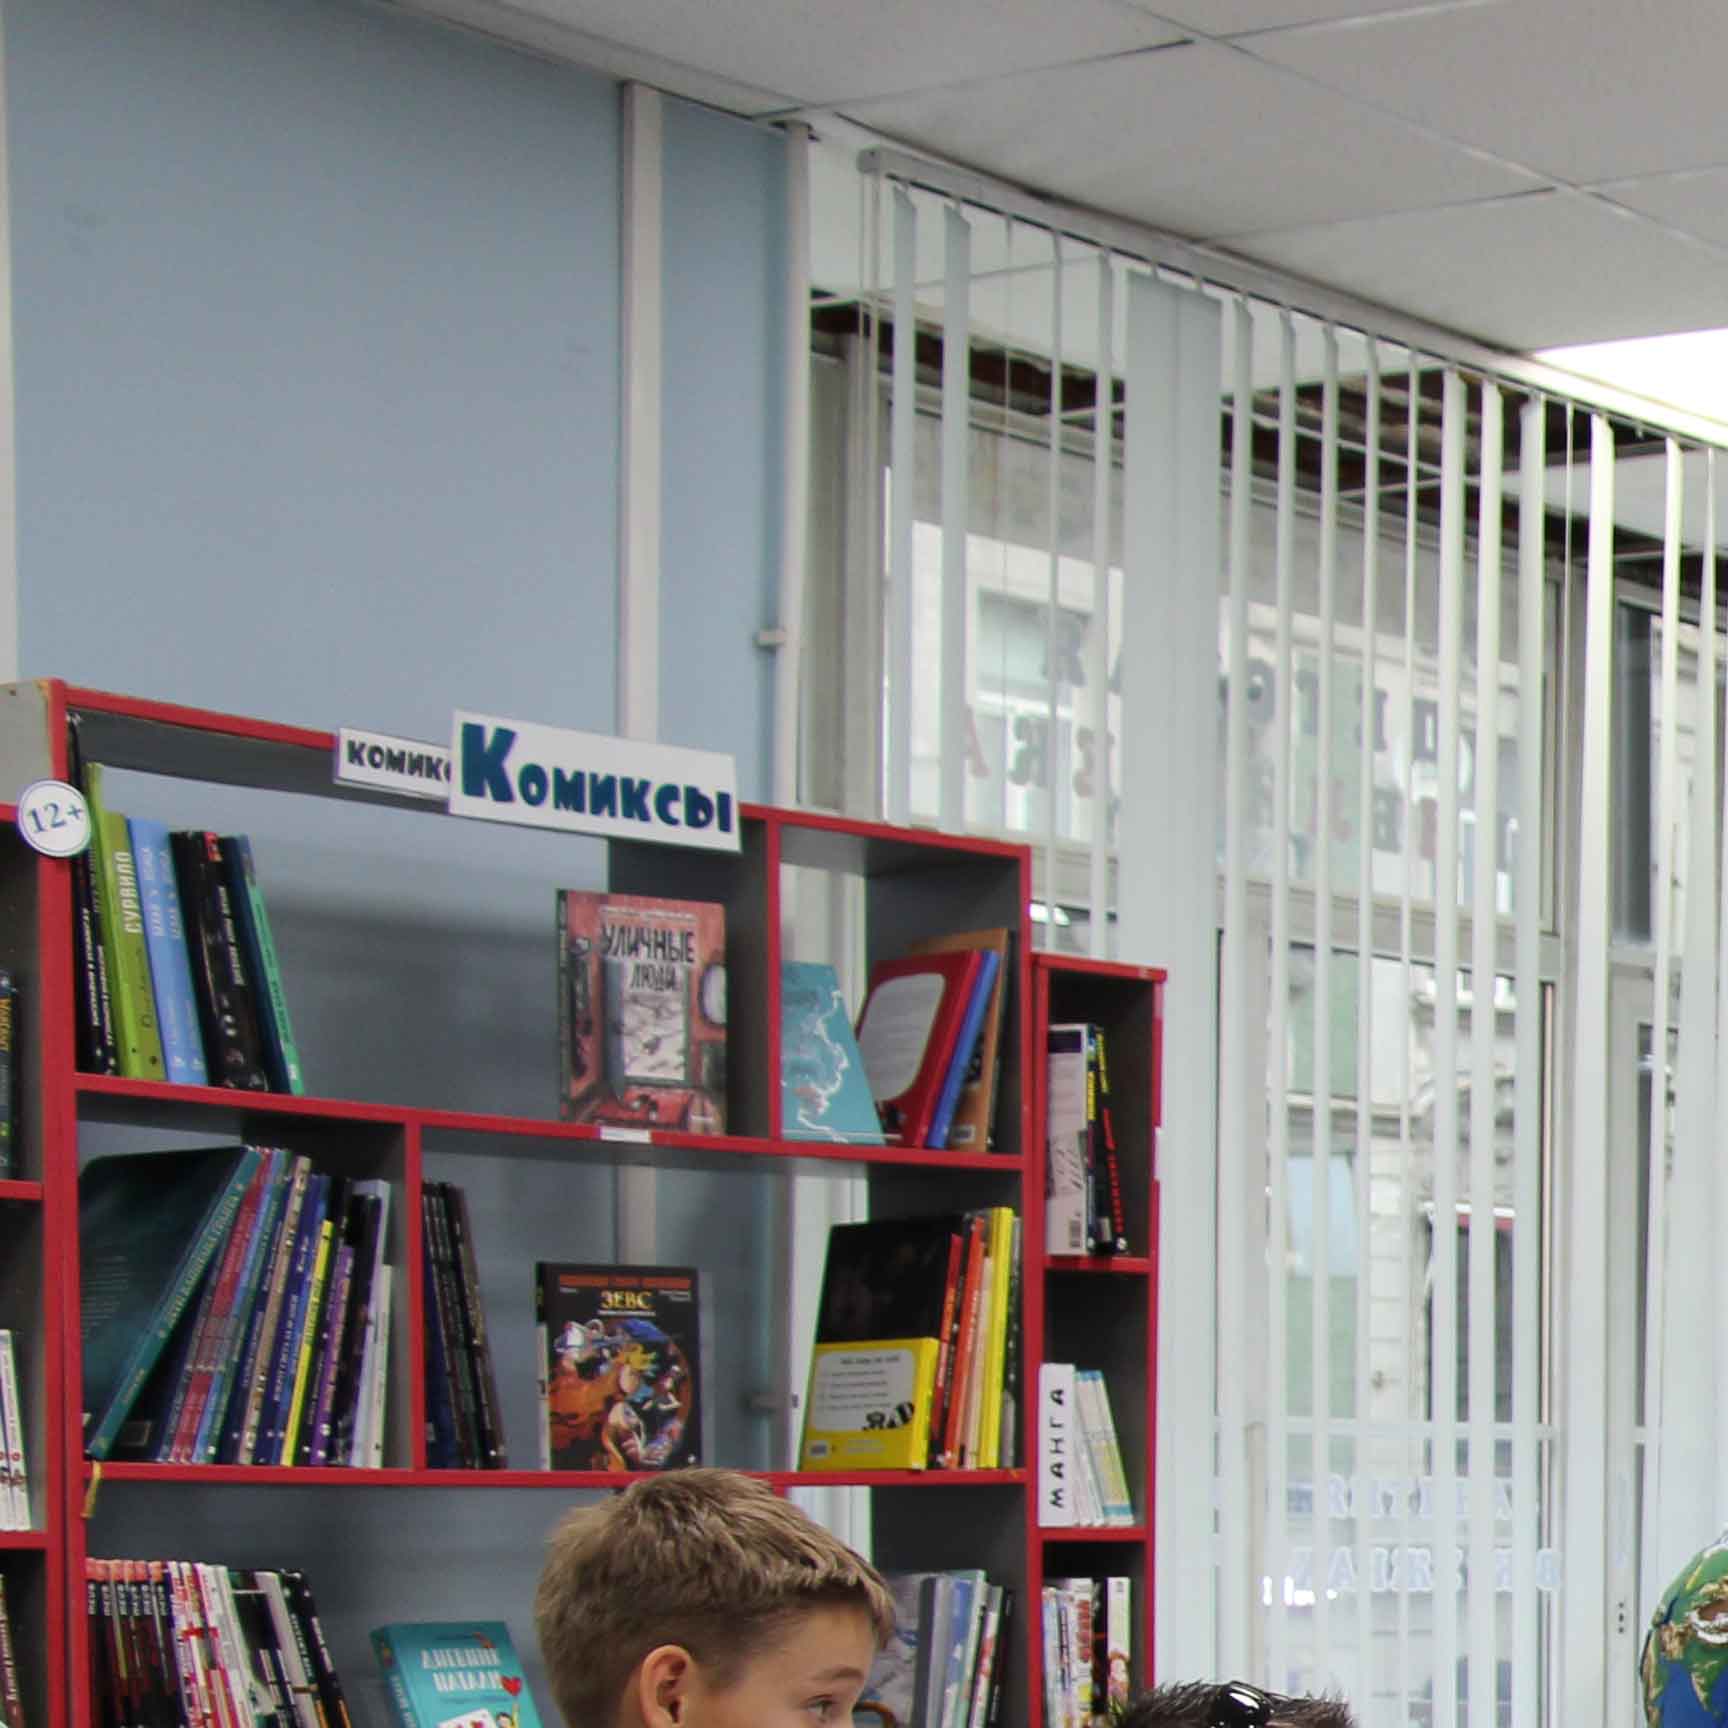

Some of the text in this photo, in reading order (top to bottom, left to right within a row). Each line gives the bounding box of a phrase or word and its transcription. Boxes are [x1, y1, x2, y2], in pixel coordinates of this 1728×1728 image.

[27, 800, 86, 836] 12+
[600, 921, 696, 967] УЛИЧНЫЕ
[599, 1289, 654, 1311] ЗЕВС
[1048, 1387, 1066, 1509] МАНГА
